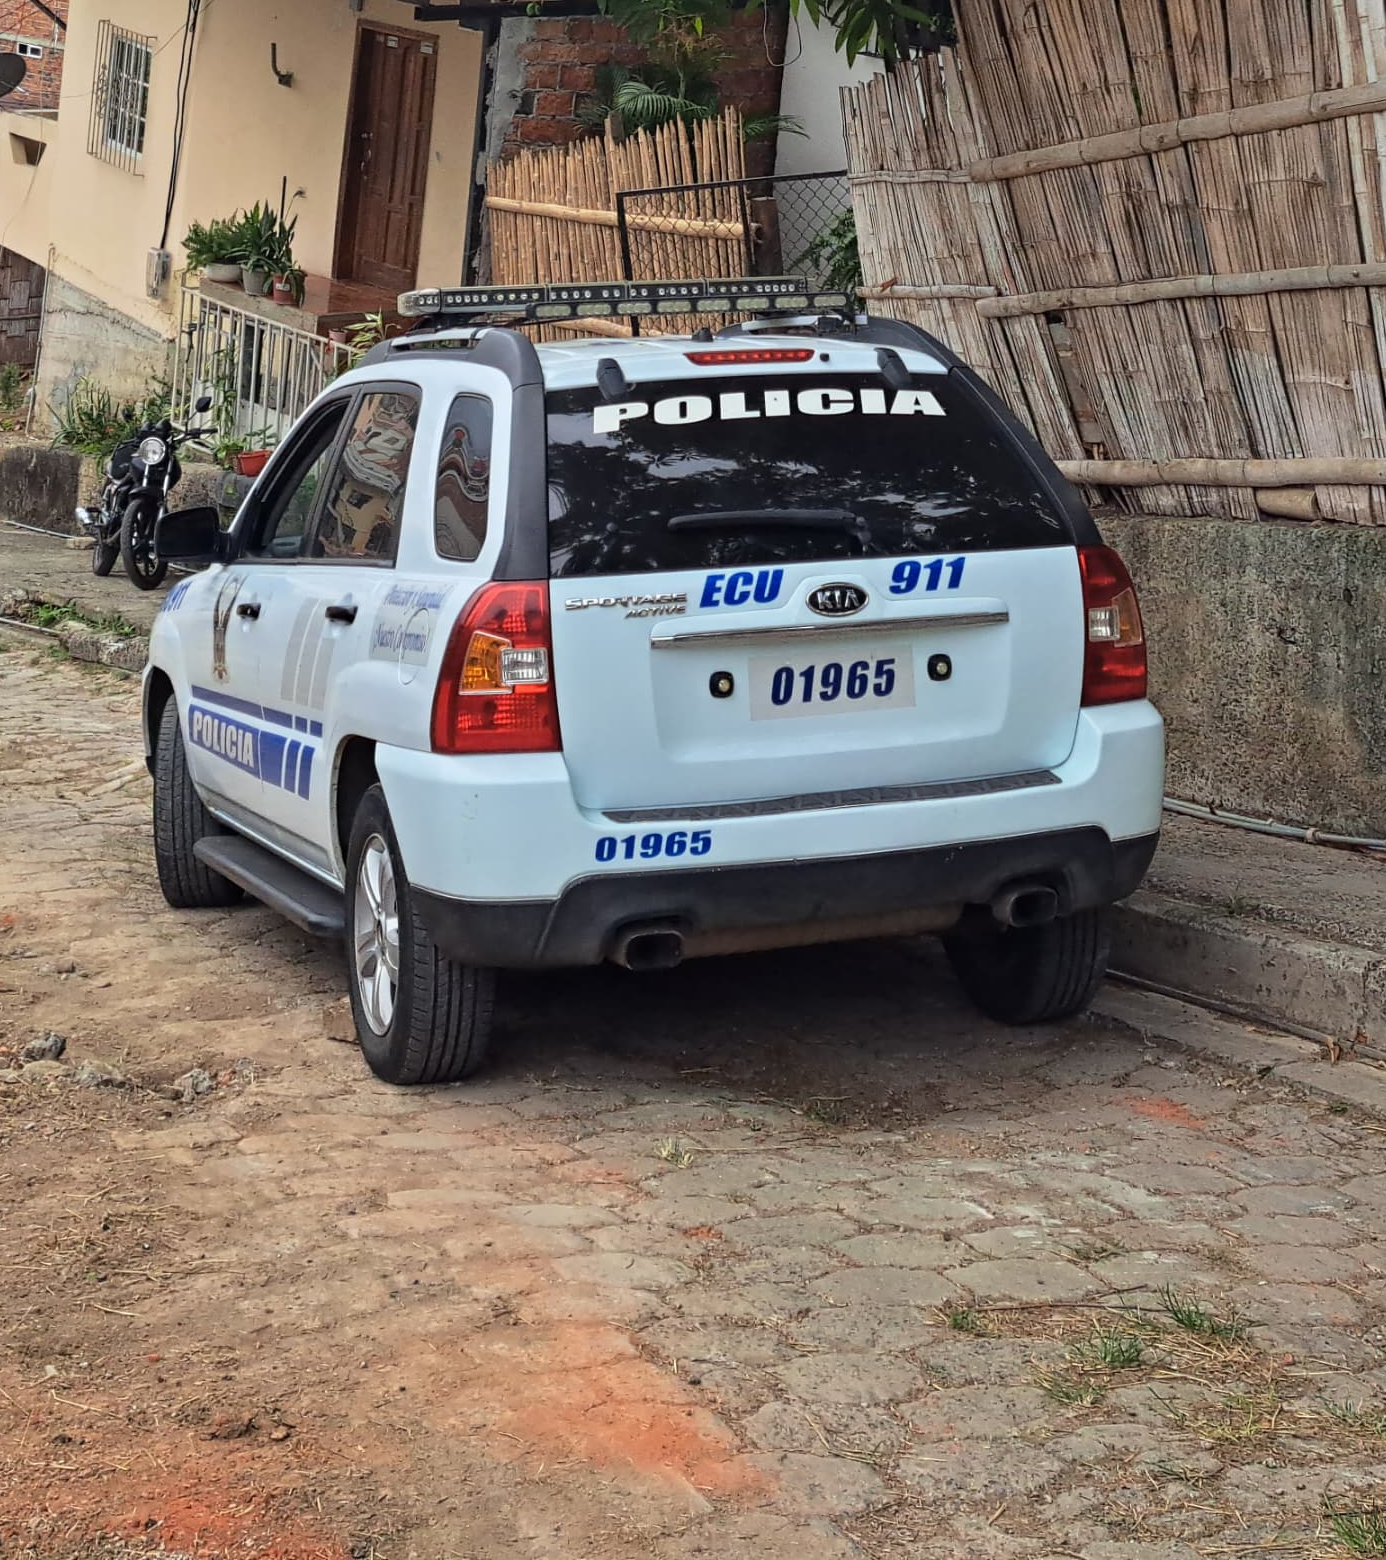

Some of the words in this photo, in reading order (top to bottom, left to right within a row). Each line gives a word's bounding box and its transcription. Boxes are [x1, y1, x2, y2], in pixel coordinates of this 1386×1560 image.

[593, 388, 946, 434] POLICIA
[699, 569, 784, 608] ECU
[889, 556, 966, 595] 911
[625, 604, 687, 619] ACTIVE
[771, 658, 896, 706] 01965
[193, 710, 255, 769] POLICIA
[595, 829, 712, 862] 01965
